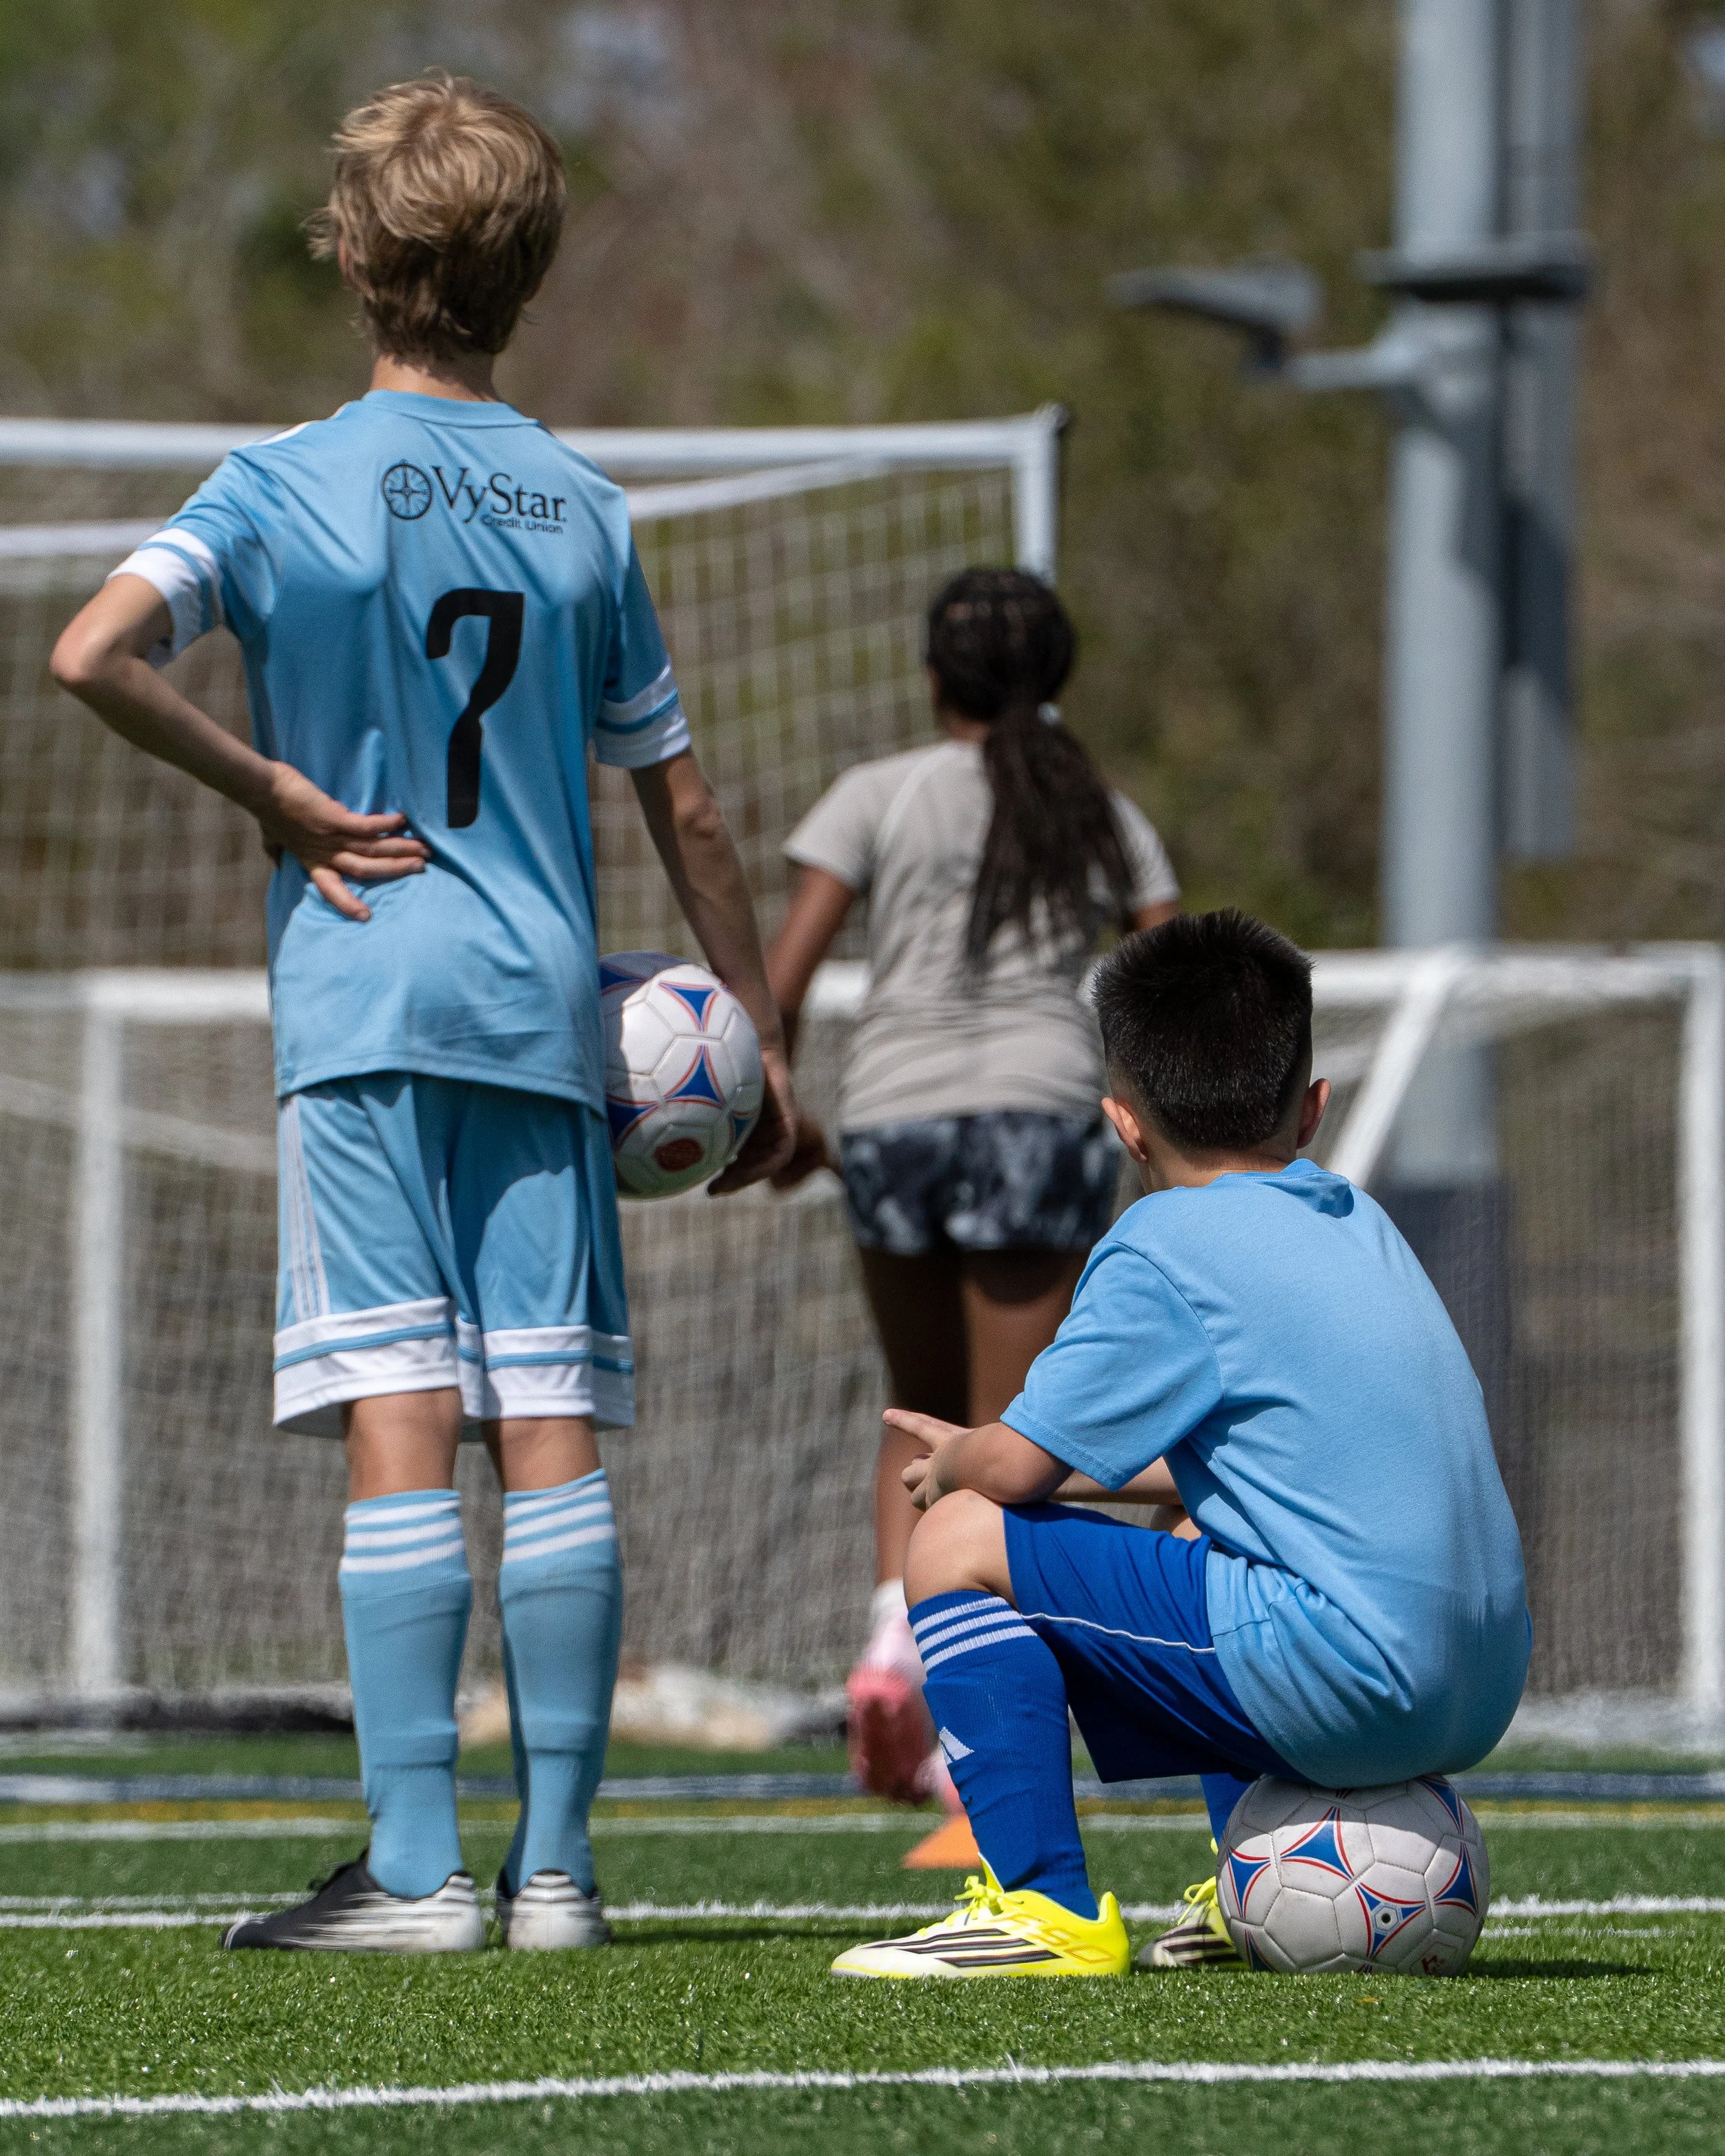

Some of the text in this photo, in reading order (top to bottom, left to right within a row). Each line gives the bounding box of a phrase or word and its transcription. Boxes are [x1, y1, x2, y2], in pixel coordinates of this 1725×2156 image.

[431, 465, 566, 524] VyStar
[481, 514, 563, 534] Credit Union
[426, 587, 524, 829] 7
